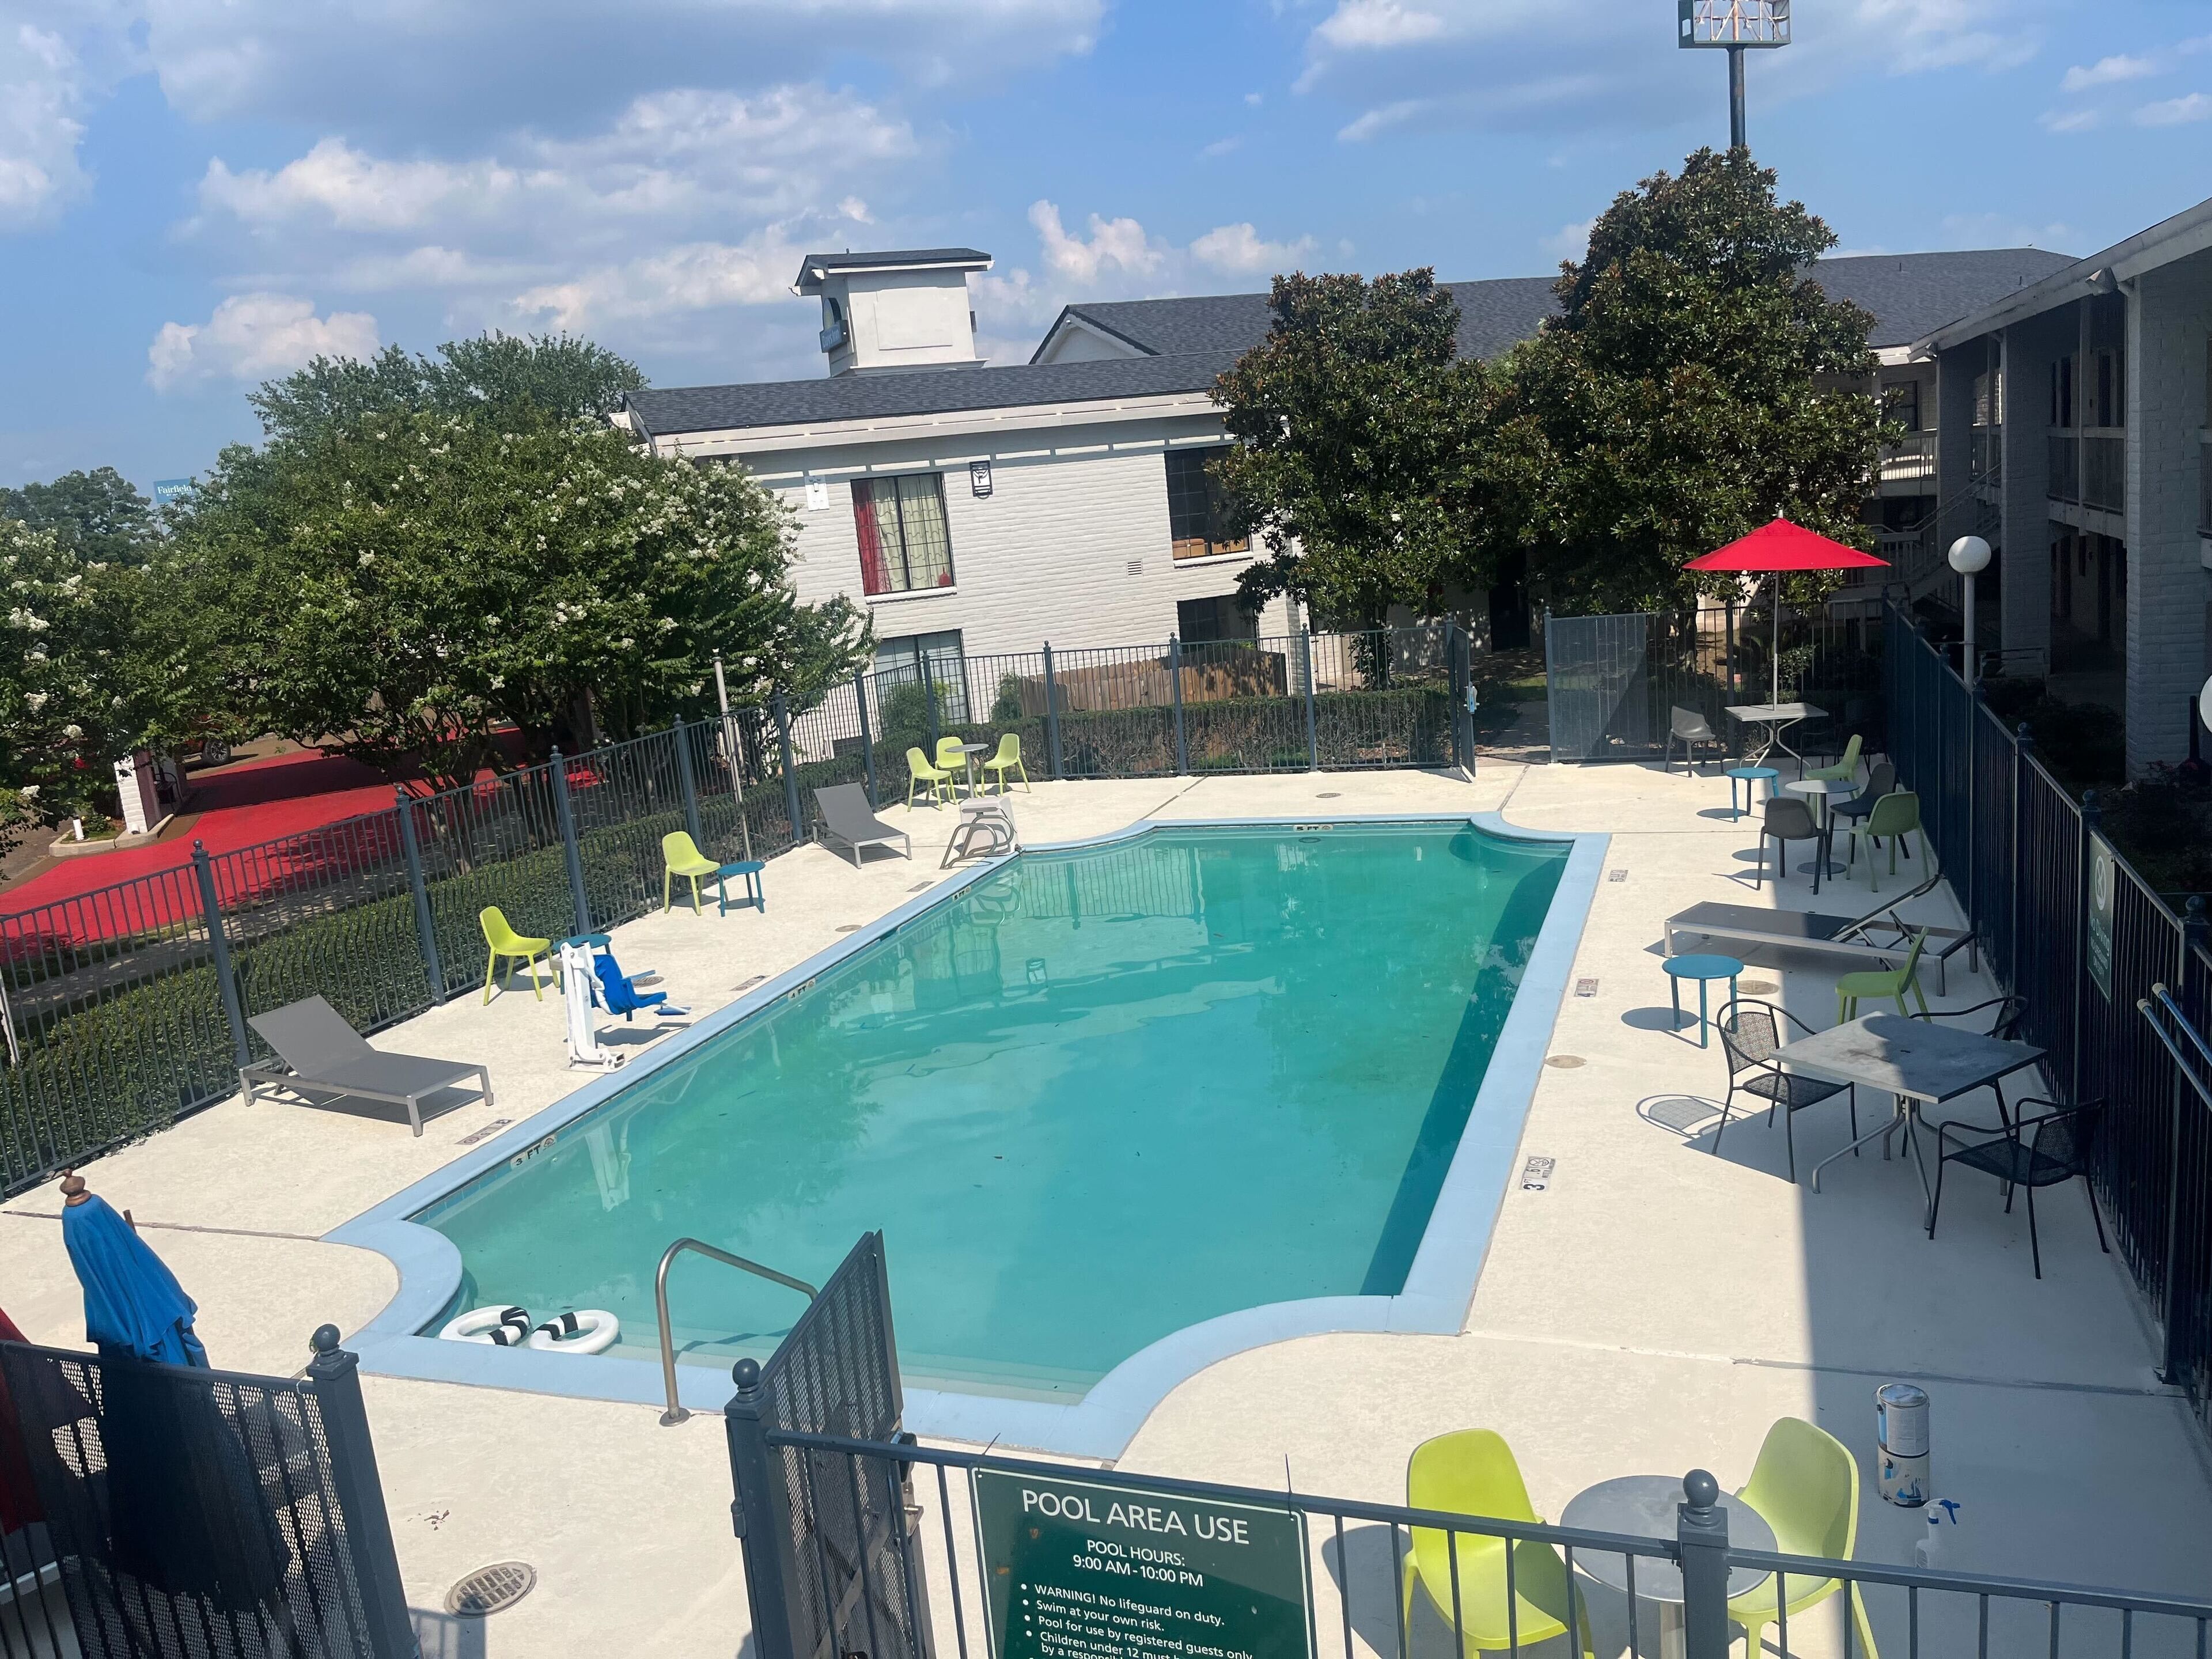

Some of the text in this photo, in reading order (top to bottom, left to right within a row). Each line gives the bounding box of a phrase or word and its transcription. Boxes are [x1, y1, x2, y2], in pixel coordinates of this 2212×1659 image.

[157, 484, 192, 494] Fairfield
[798, 985, 806, 995] FT
[516, 1143, 540, 1166] 3 FT
[1022, 1489, 1249, 1545] POOL AREA USE
[1087, 1539, 1185, 1567] POOL HOURS:
[1073, 1554, 1101, 1570] 9:00
[1105, 1560, 1131, 1575] AM
[1140, 1565, 1176, 1582] 10:00
[1179, 1571, 1203, 1587] PM
[1035, 1584, 1225, 1627] WARNING! No lifeguard on duty.
[1037, 1600, 1165, 1631] Swim at your own risk.
[1039, 1615, 1063, 1629] Pool
[1065, 1620, 1082, 1632] for
[1085, 1626, 1105, 1637] use
[1107, 1627, 1121, 1641] by
[1124, 1633, 1183, 1650] registered
[1186, 1643, 1224, 1657] guests
[1040, 1631, 1087, 1649] Children
[1090, 1642, 1123, 1655] under
[1127, 1647, 1139, 1658] 12
[1041, 1642, 1055, 1656] by
[1058, 1648, 1065, 1656] a
